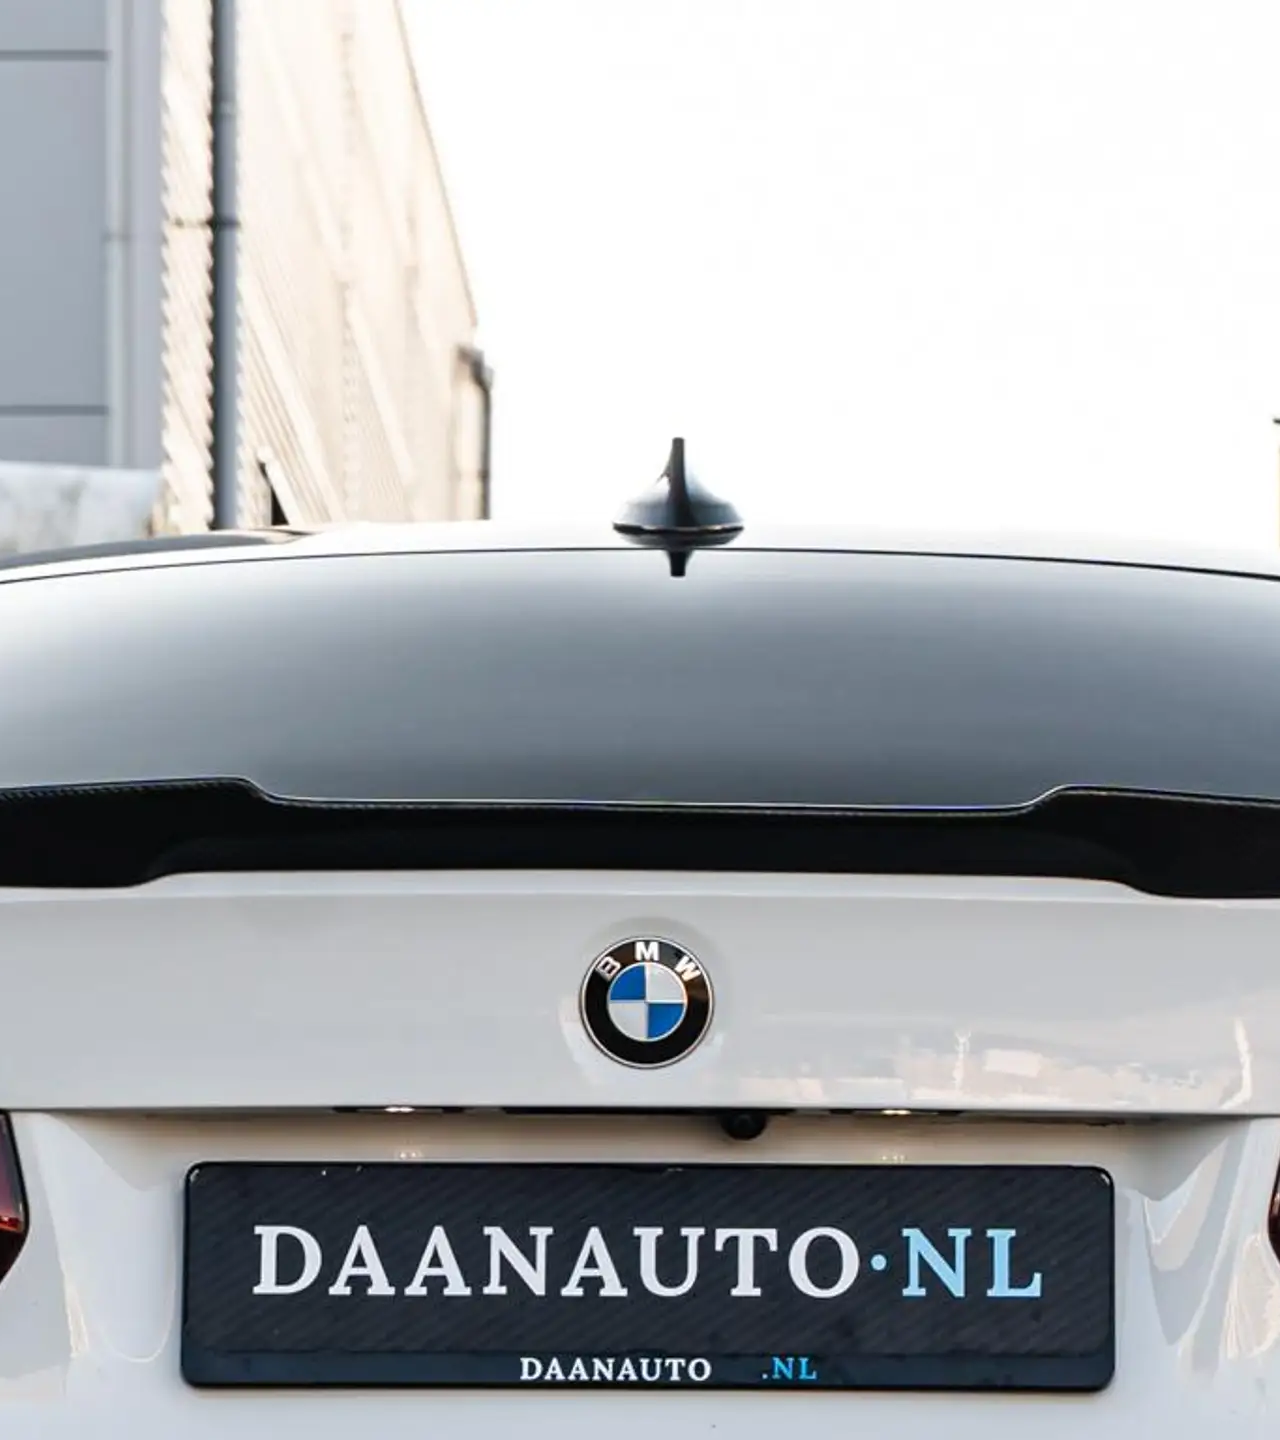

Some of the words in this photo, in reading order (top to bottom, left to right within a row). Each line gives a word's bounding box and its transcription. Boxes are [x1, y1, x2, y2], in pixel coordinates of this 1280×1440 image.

[594, 940, 701, 982] BMW
[519, 1357, 712, 1382] DAANAUTO
[762, 1357, 817, 1381] .NL
